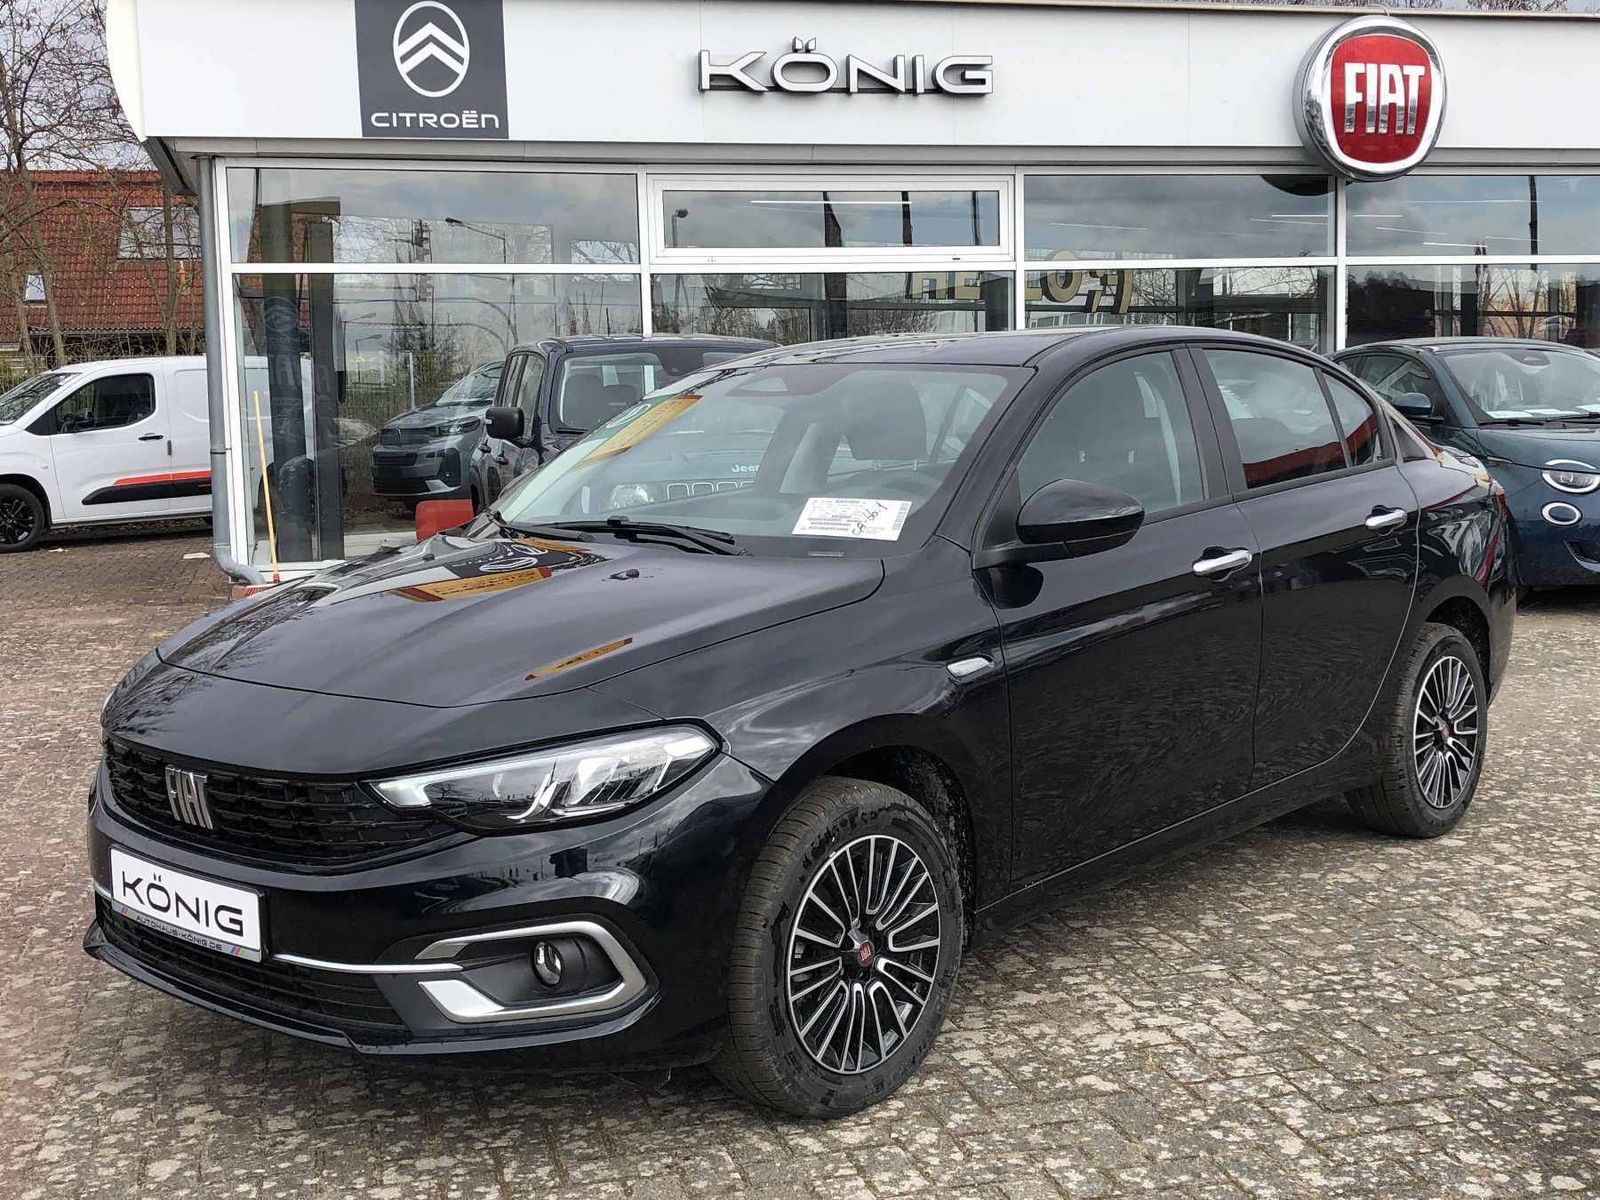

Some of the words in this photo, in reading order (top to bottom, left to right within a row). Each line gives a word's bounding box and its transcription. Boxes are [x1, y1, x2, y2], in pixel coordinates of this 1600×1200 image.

[699, 36, 993, 95] KÖNIG
[1344, 62, 1425, 134] FIAT
[165, 765, 214, 830] FIAT
[122, 870, 244, 938] KÖNIG
